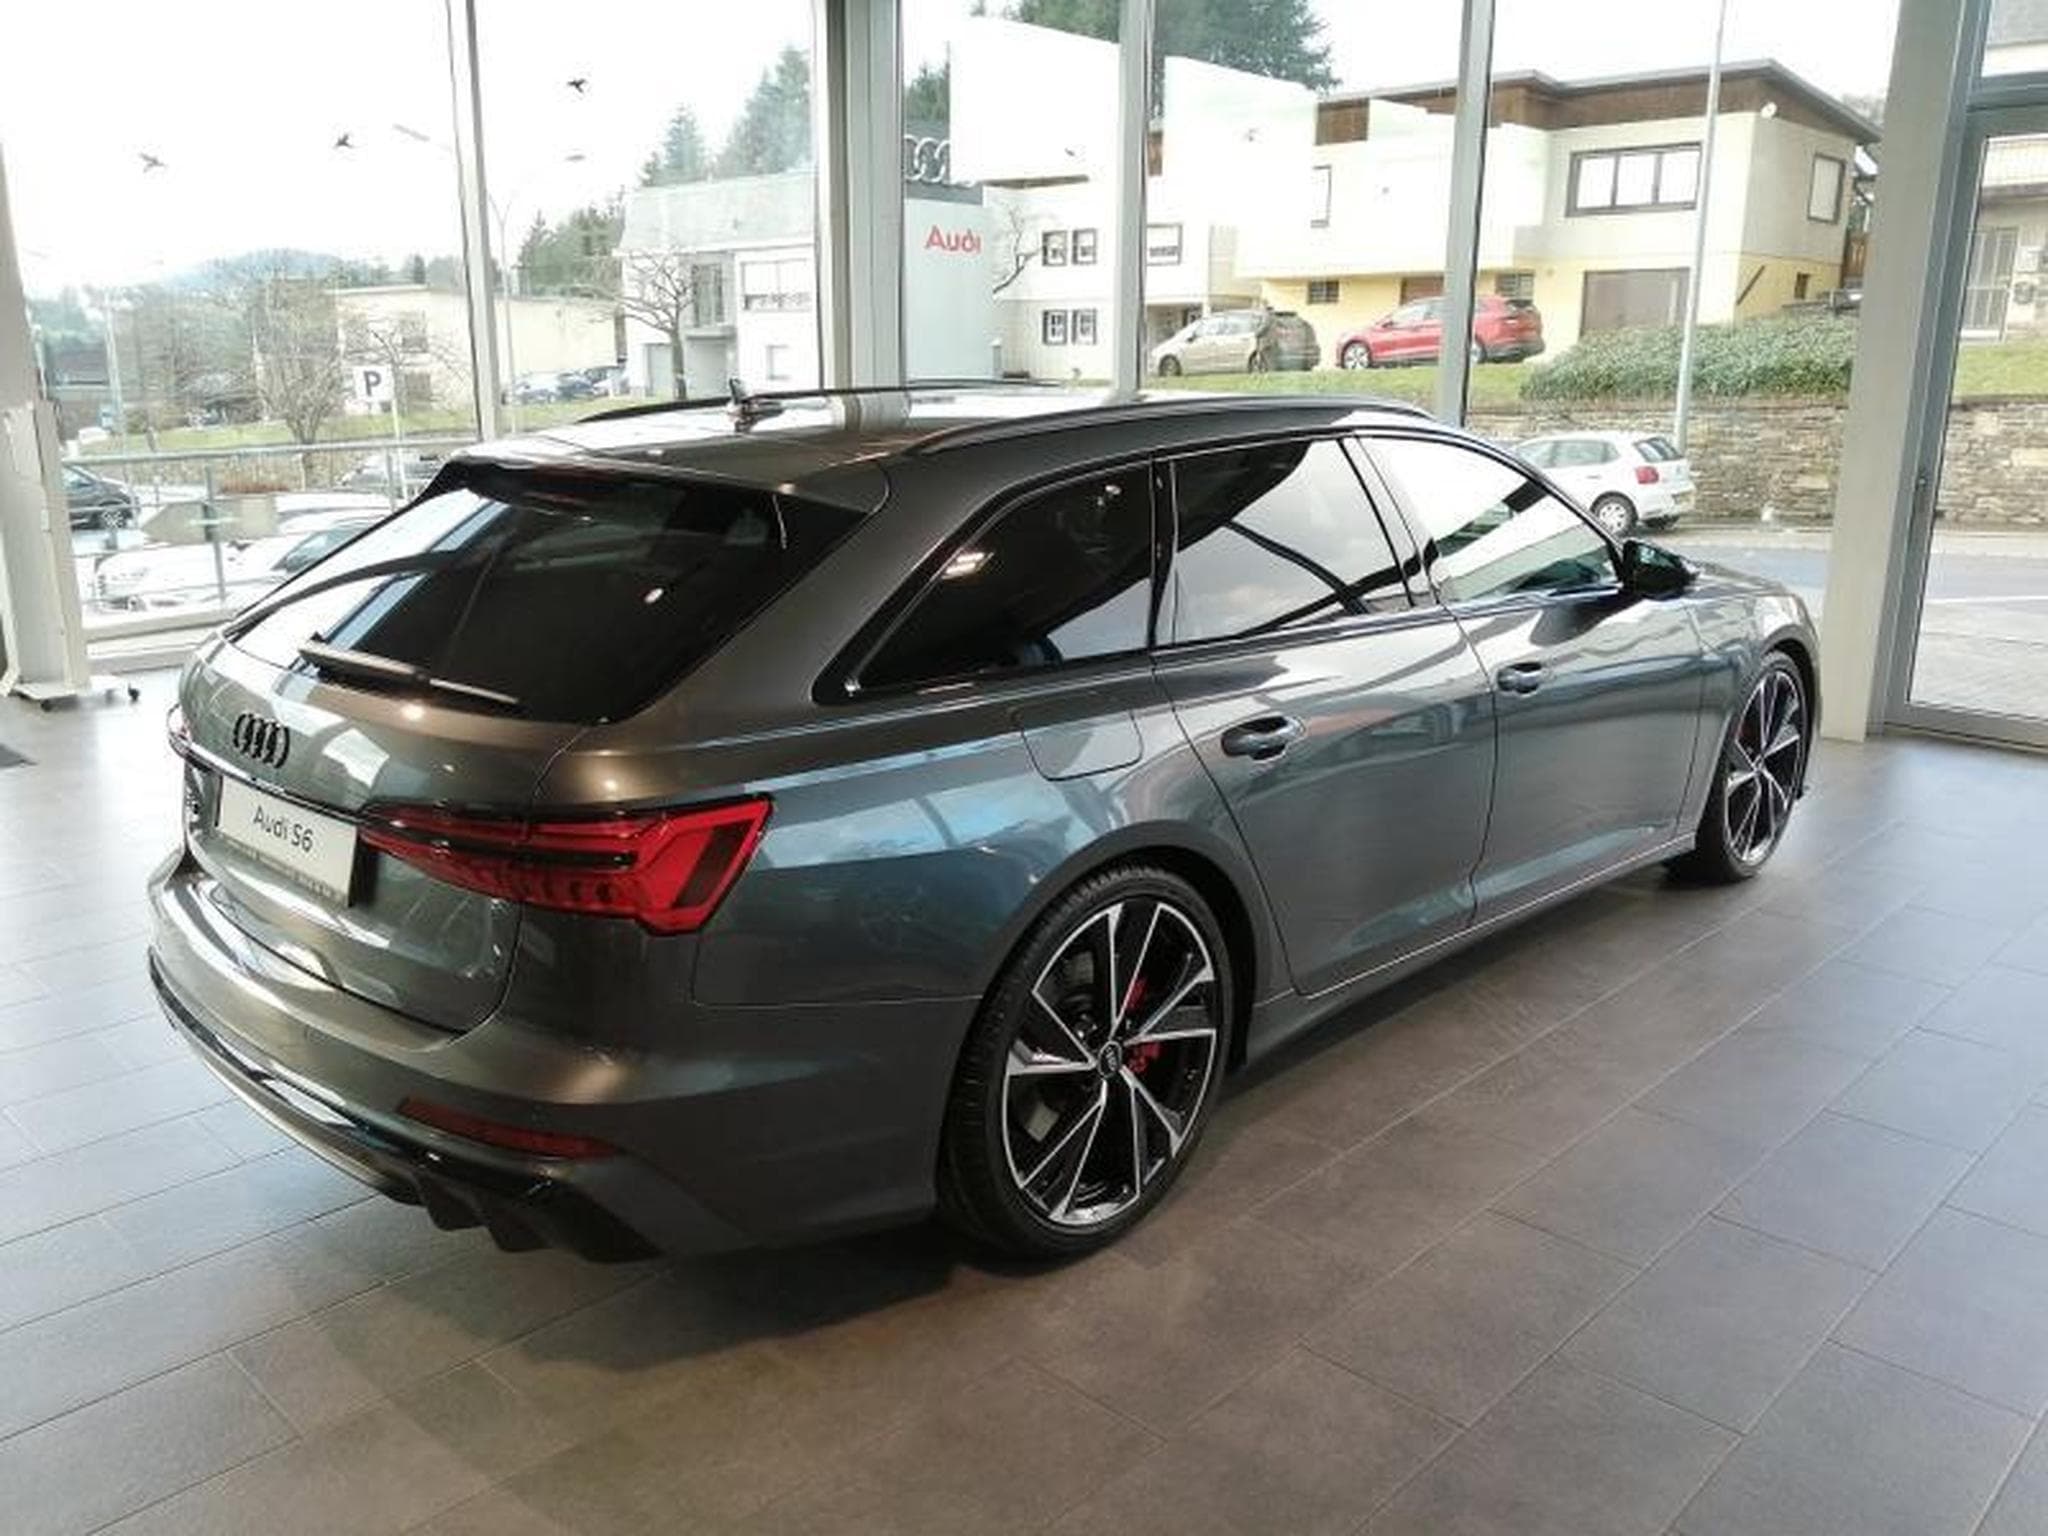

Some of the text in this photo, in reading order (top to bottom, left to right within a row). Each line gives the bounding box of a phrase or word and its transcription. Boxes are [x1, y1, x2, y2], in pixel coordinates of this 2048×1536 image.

[924, 224, 981, 254] Audi
[363, 370, 382, 397] P
[252, 804, 315, 854] Audi S6
